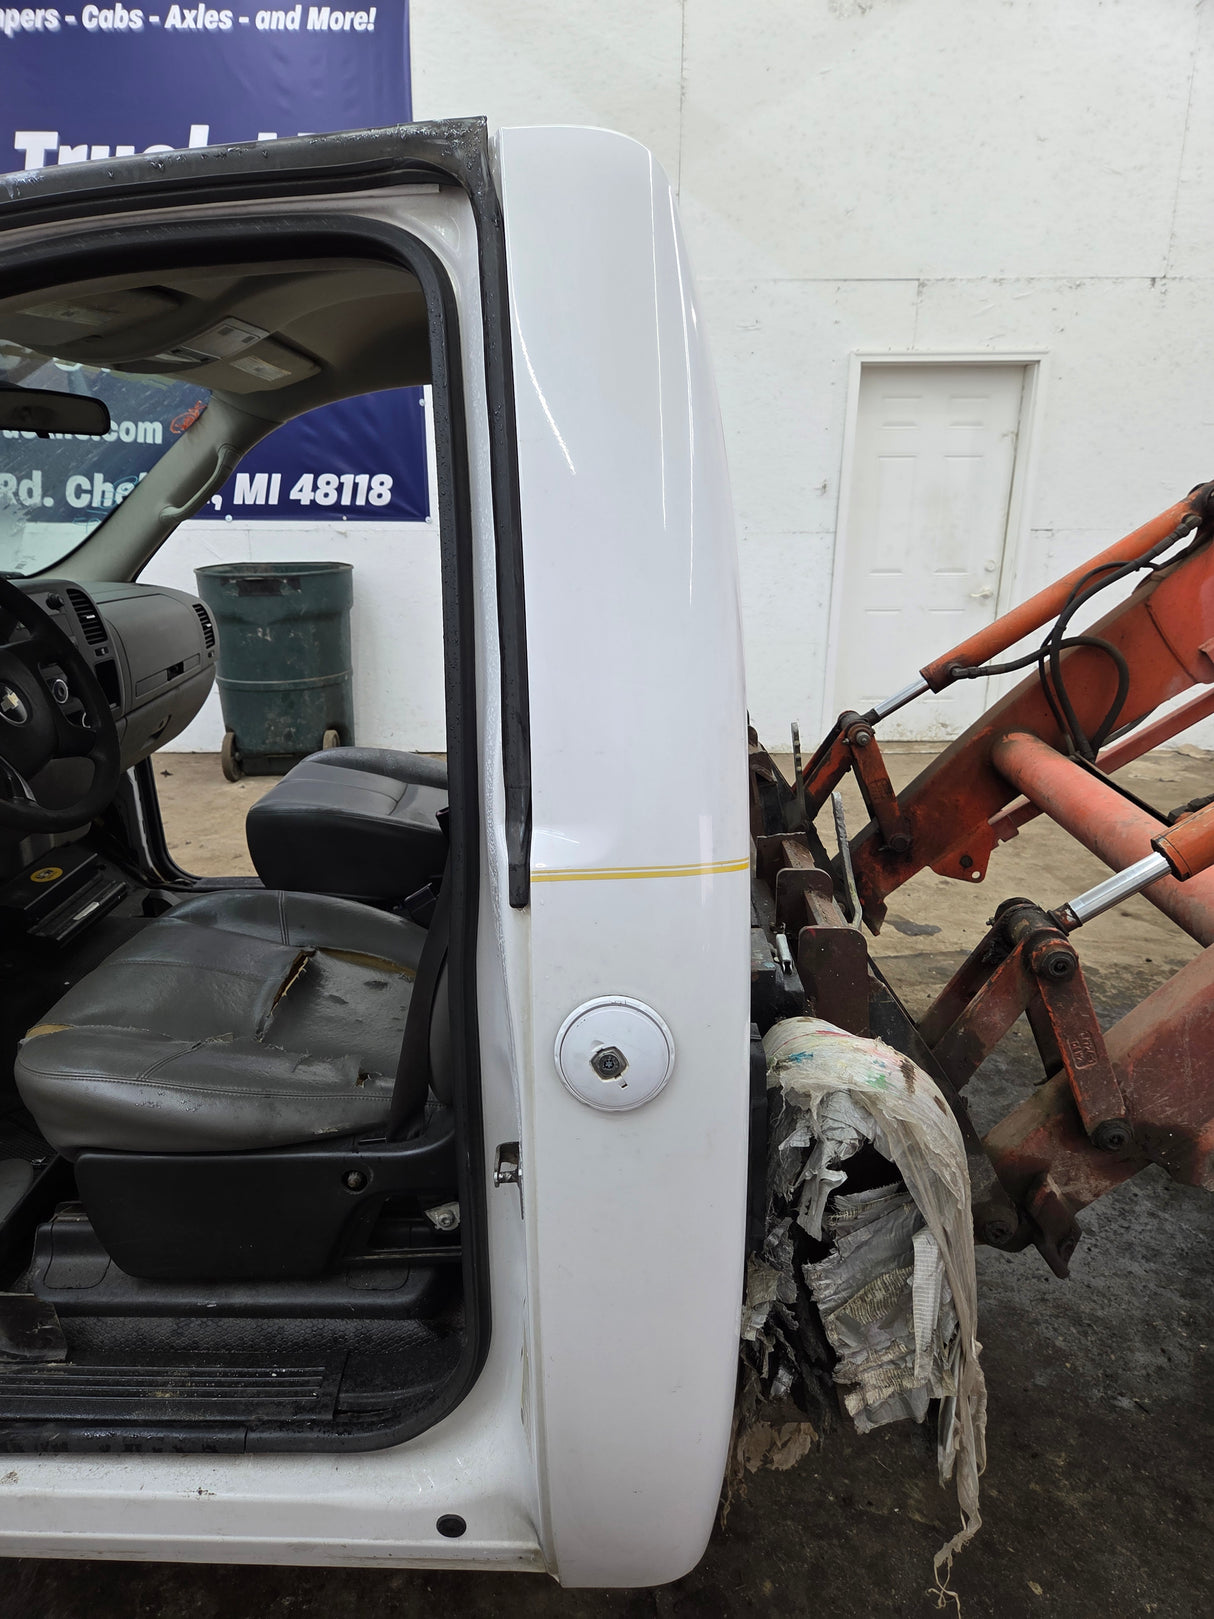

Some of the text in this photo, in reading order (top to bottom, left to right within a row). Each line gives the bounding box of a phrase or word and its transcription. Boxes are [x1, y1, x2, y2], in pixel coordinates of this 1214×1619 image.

[82, 3, 143, 30] Cabs
[165, 4, 233, 30] Axles
[255, 5, 300, 30] and
[307, 7, 377, 31] More!
[233, 473, 282, 505] MI
[290, 473, 394, 505] 48118
